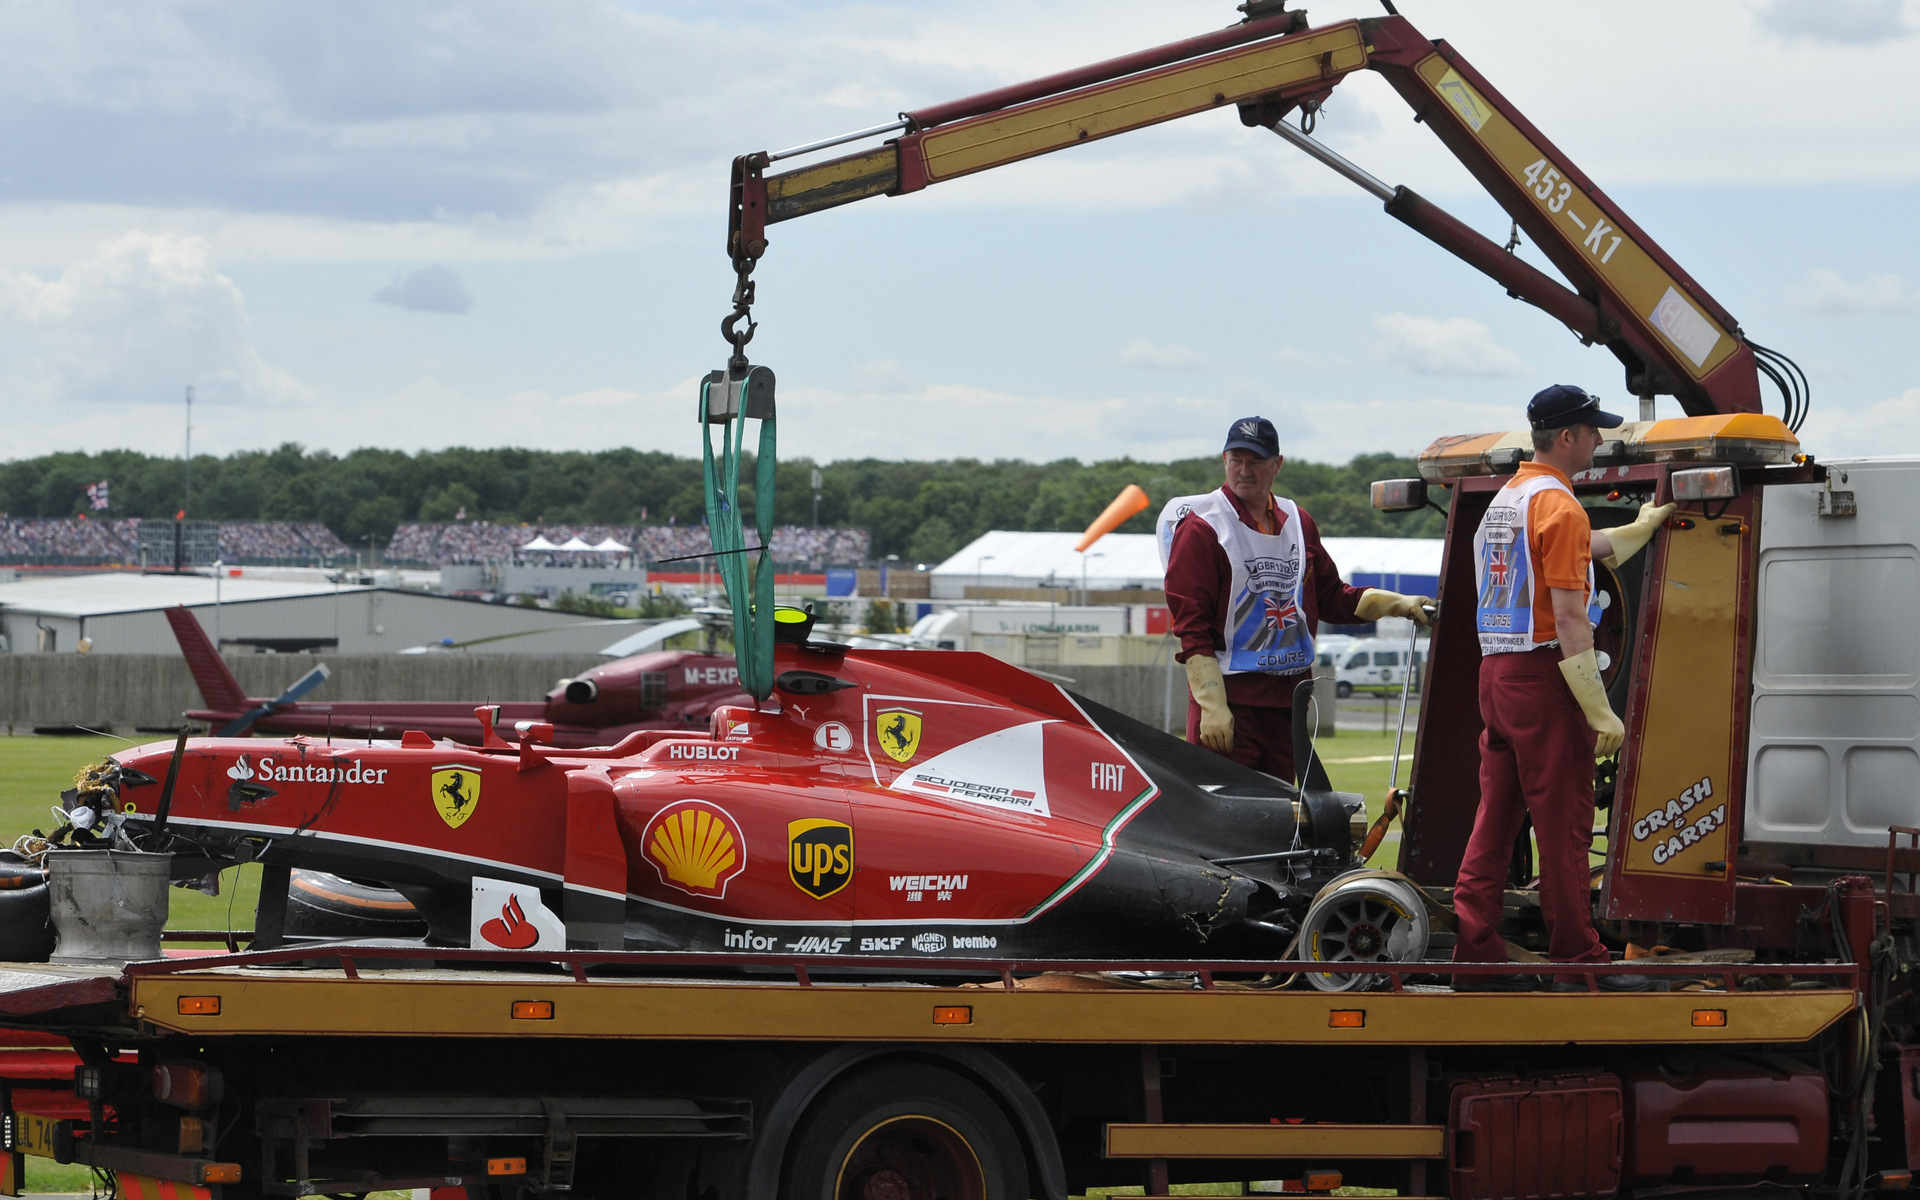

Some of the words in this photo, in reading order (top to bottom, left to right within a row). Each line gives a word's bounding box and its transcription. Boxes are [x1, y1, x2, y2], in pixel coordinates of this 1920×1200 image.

[1022, 624, 1099, 633] LONMARSH
[670, 745, 740, 760] HUBLOT
[258, 757, 388, 785] Santander
[1091, 762, 1126, 792] FIAT
[915, 774, 1009, 796] SCUDERIA
[951, 788, 1032, 807] FERRARI
[1633, 777, 1713, 841] CRASH
[1653, 804, 1725, 865] CARRY
[889, 875, 968, 891] WEICHAI
[724, 928, 778, 950] infor
[785, 936, 851, 953] HAAS
[860, 937, 905, 951] SKF
[911, 932, 946, 944] MAGNETI
[953, 935, 997, 949] brembo
[911, 941, 946, 953] MARELLI
